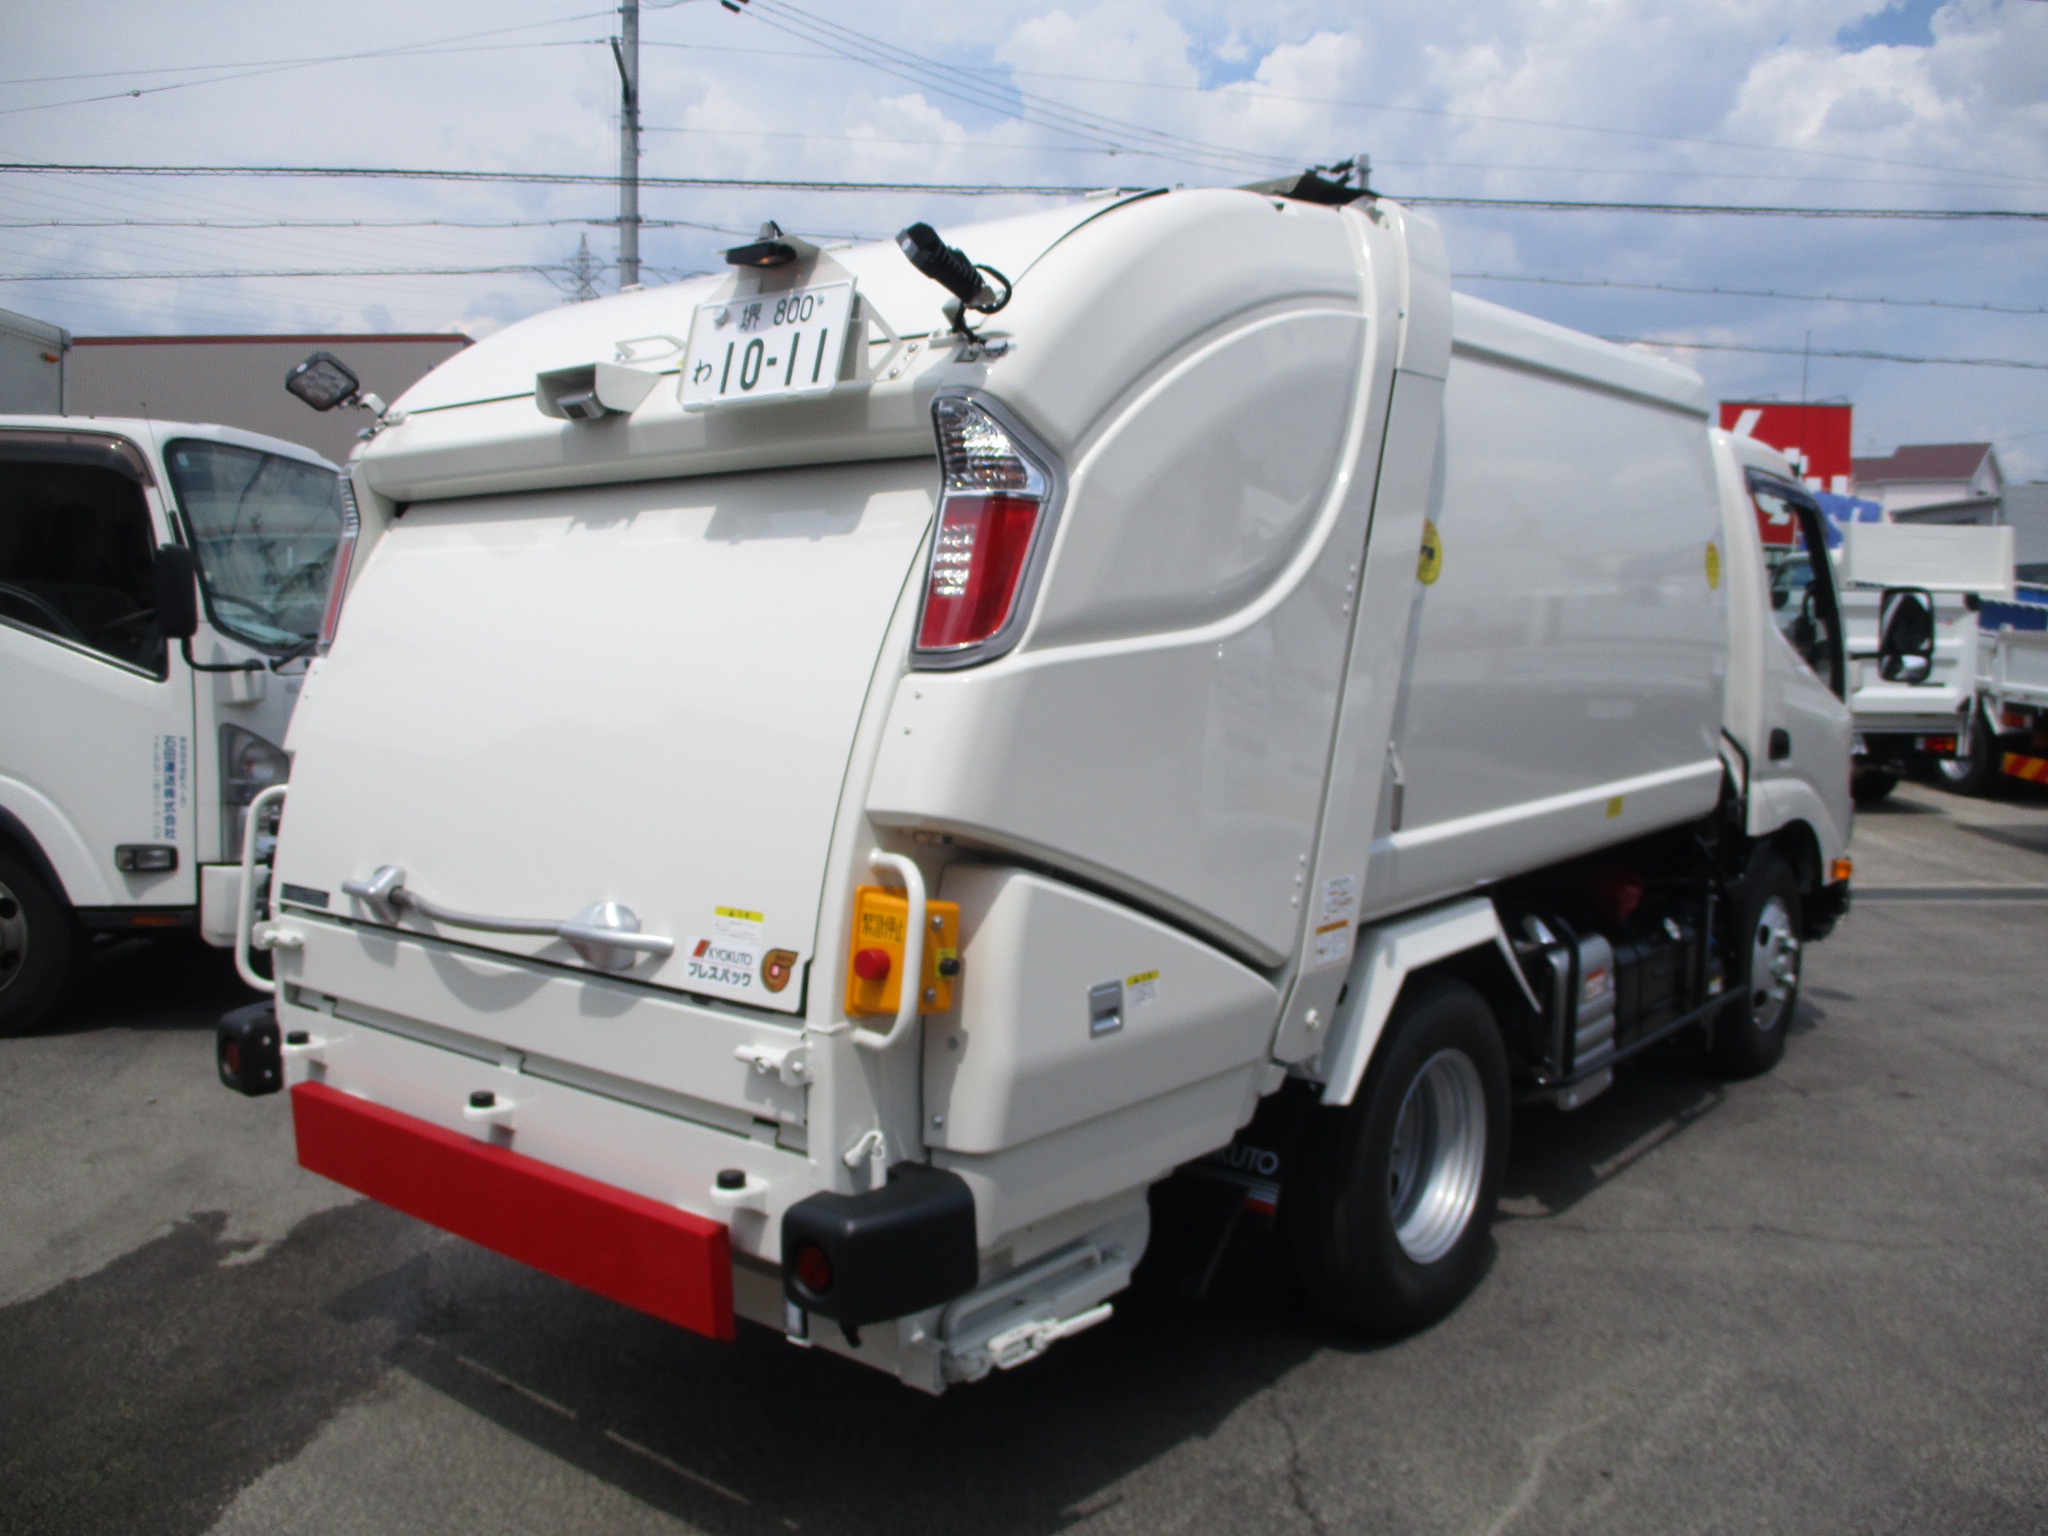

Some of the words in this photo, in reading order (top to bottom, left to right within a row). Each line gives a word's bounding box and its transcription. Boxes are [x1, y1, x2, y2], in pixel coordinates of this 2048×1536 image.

[740, 302, 762, 330] 堺
[774, 295, 813, 325] 800
[692, 360, 712, 385] わ
[719, 328, 828, 394] 10-11
[708, 947, 753, 966] KYOKUTO
[688, 962, 752, 987] プレスパック
